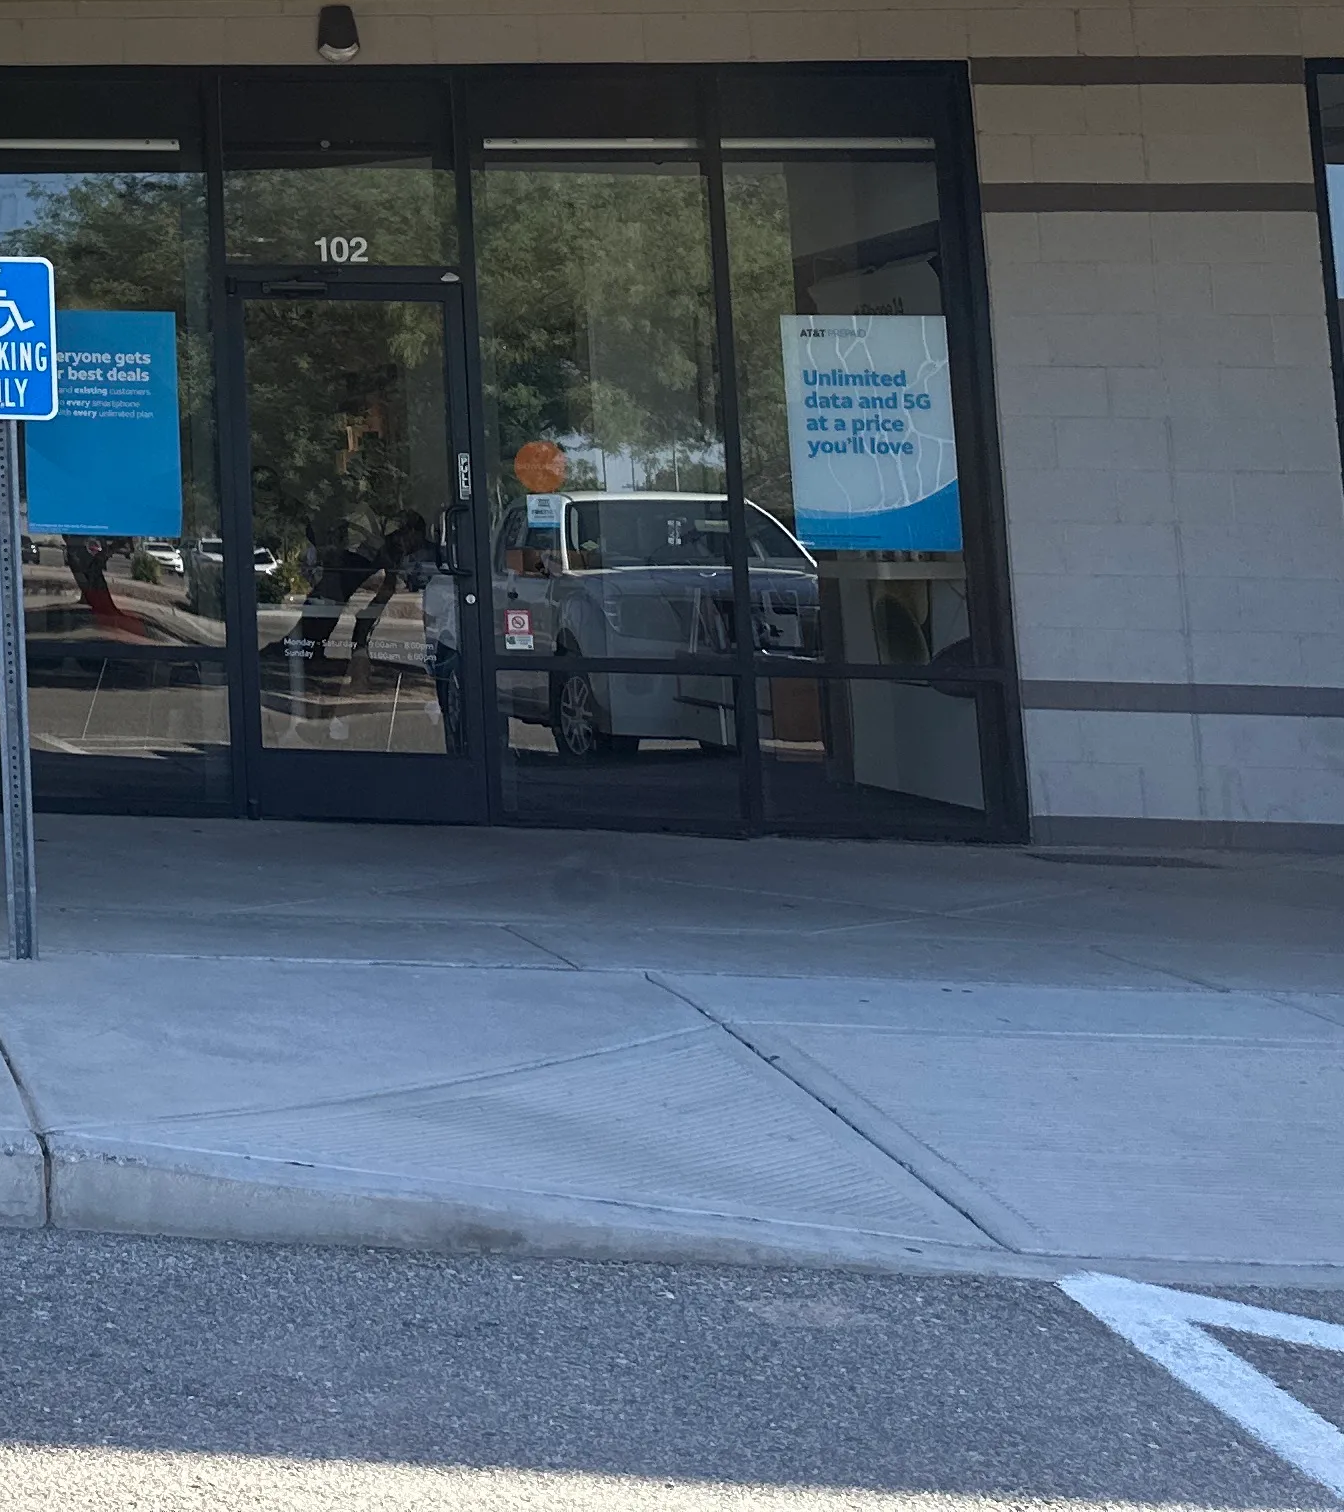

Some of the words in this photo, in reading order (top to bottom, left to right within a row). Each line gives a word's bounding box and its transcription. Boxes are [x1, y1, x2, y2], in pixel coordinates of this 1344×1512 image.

[315, 237, 368, 262] 102
[800, 329, 826, 338] AT&T
[828, 329, 866, 338] PREPAID
[56, 351, 112, 366] eryone
[114, 351, 151, 367] gets
[67, 366, 103, 380] best
[107, 367, 150, 381] deals
[802, 368, 907, 387] Unlimited
[74, 386, 108, 396] existing
[66, 399, 91, 409] every
[804, 391, 853, 409] data
[858, 392, 898, 409] and
[903, 393, 931, 410] 5G
[73, 410, 97, 419] every
[99, 409, 135, 418] unlimited
[806, 415, 829, 431] at
[834, 419, 846, 431] a
[852, 414, 904, 436] price
[807, 437, 864, 458] you'll
[870, 437, 913, 454] love
[460, 457, 469, 488] PULL
[283, 638, 315, 648] Monday
[322, 639, 358, 650] Saturday
[284, 649, 314, 659] Sunday
